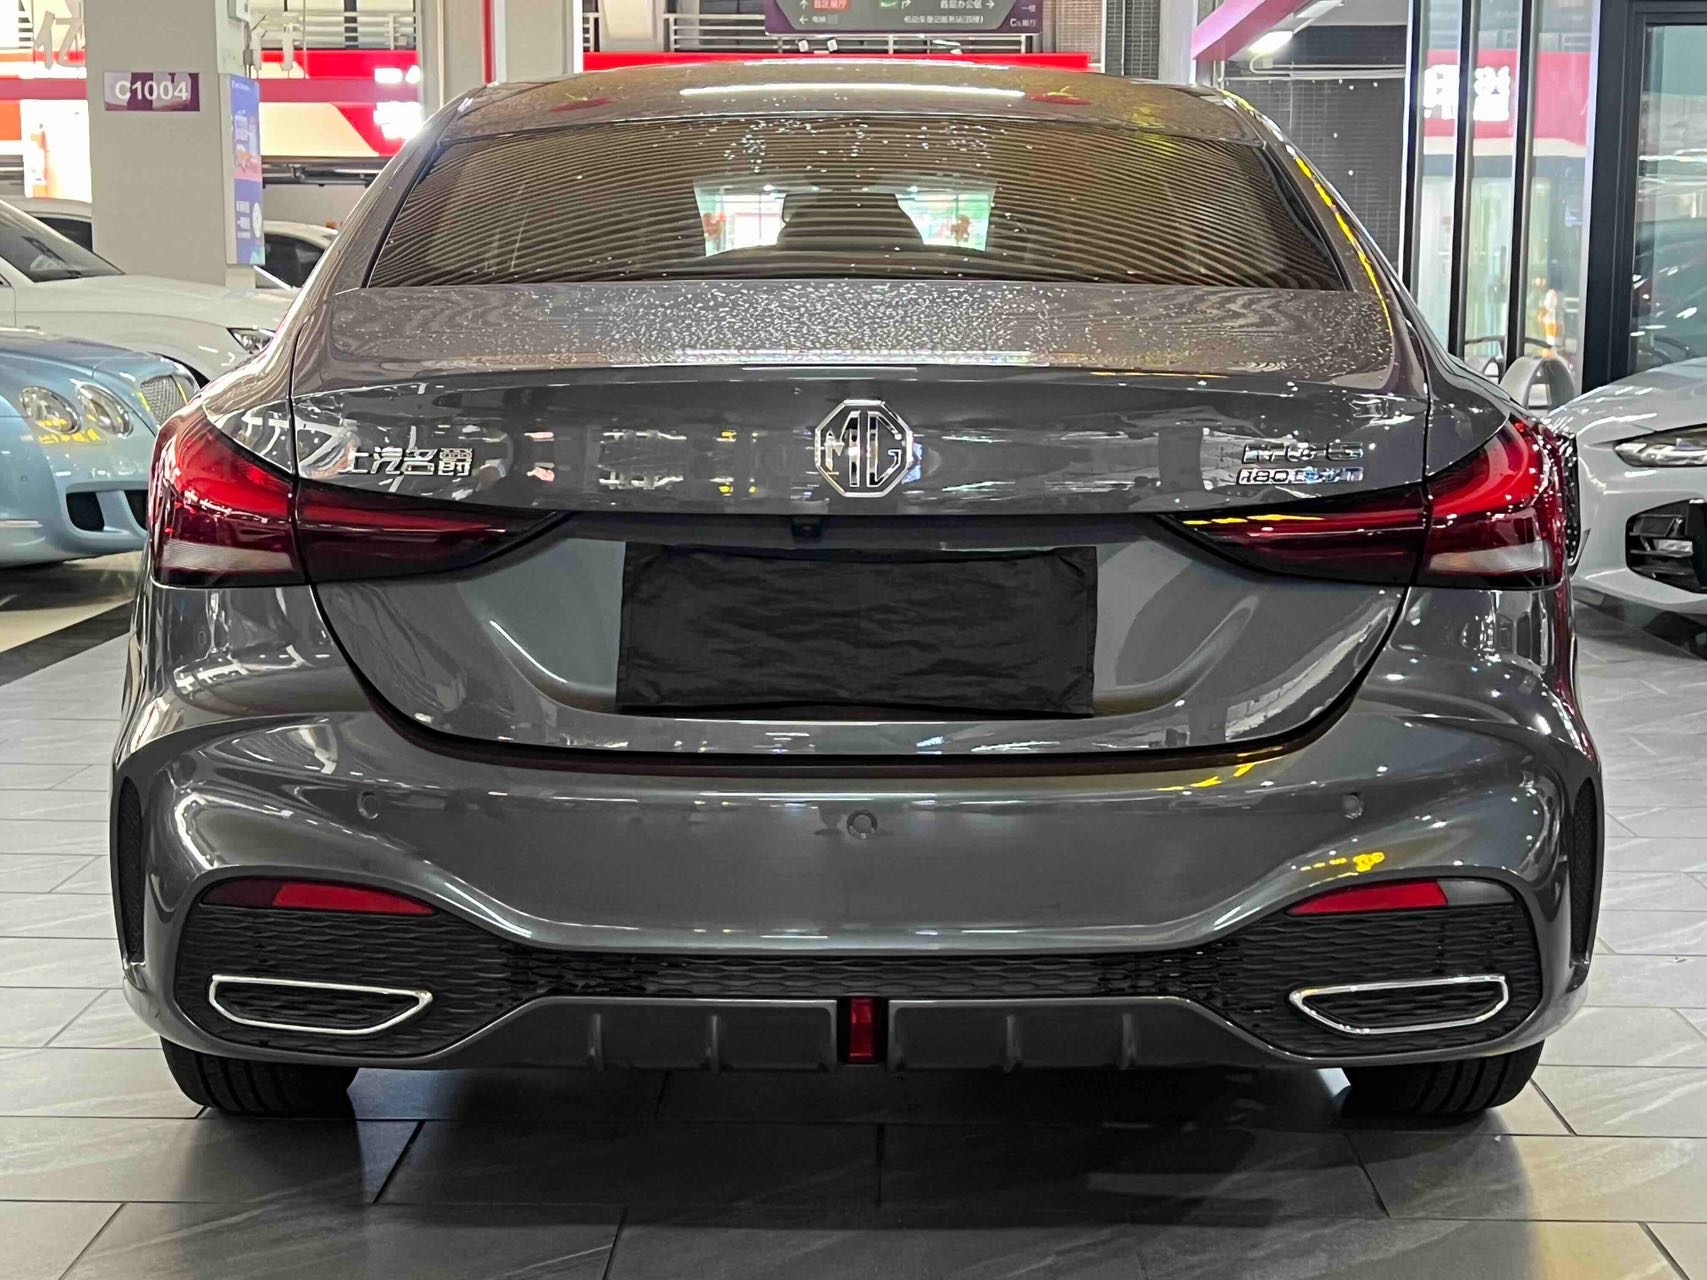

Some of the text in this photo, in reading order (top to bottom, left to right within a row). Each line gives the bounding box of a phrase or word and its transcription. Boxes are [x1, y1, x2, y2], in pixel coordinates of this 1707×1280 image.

[114, 80, 189, 101] C1004
[338, 446, 473, 477] 上汽名爵
[823, 408, 904, 489] MG
